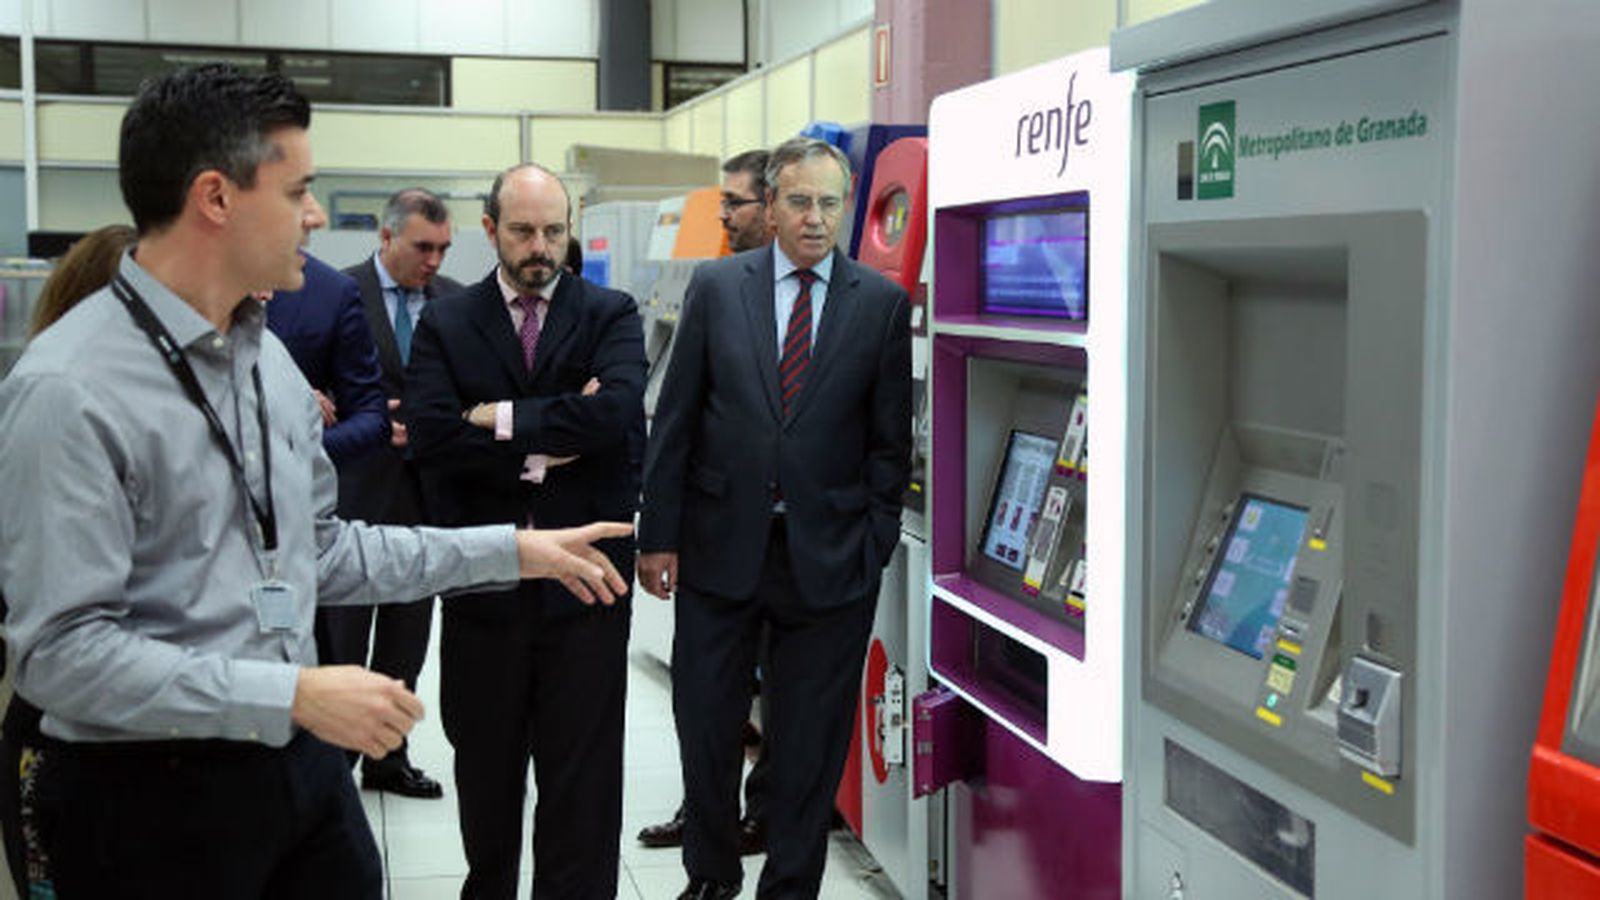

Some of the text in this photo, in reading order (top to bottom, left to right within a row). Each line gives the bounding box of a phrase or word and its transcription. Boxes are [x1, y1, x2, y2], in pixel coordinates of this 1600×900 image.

[1016, 70, 1091, 178] renfe
[1239, 110, 1428, 159] Metropolitano de Granada
